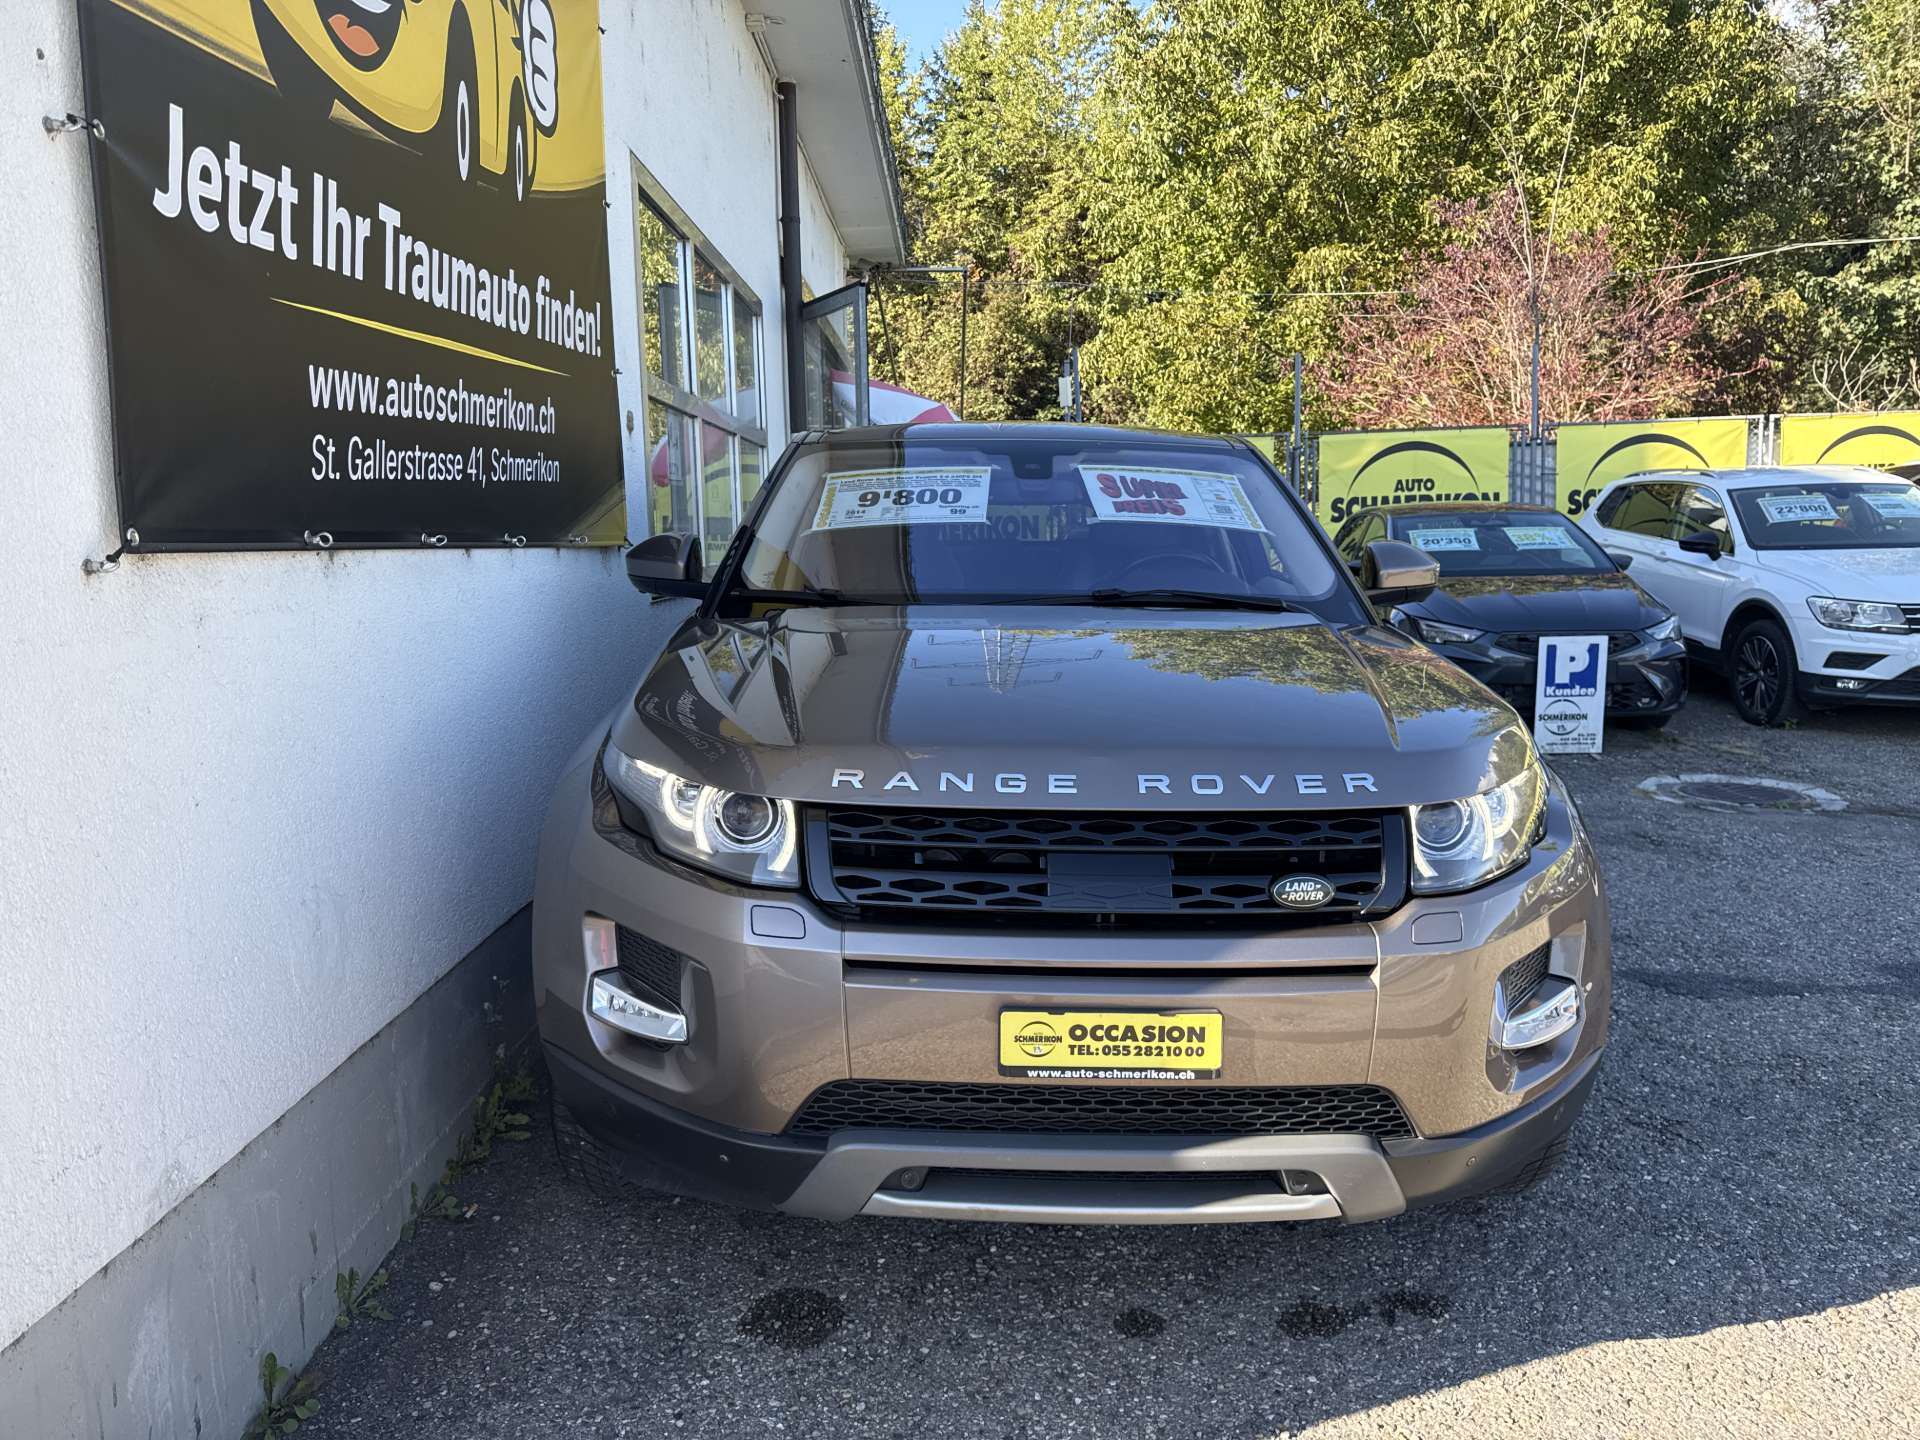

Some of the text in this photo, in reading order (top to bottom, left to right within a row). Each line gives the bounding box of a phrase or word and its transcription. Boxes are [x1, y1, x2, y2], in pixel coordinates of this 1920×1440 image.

[152, 102, 602, 358] Jetzt Ihr Traumauto finden!
[308, 363, 556, 436] www.autoschmerikon.ch
[311, 434, 560, 489] St. Gallerstrasse 41, Schmerikon
[1394, 478, 1435, 492] AUTO
[857, 488, 962, 508] 9'800
[1545, 684, 1596, 697] Kunden
[1538, 713, 1588, 721] SCHMERIKON
[831, 768, 1380, 795] RANGE ROVER
[1285, 882, 1315, 891] LAND
[1287, 891, 1324, 901] ROVER
[1014, 1034, 1063, 1043] SCHMERIKON
[1068, 1024, 1206, 1043] OCCASION
[1068, 1044, 1100, 1056] TEL:
[1102, 1045, 1131, 1057] 055
[1027, 1067, 1195, 1080] www.auto-schmerikon.ch
